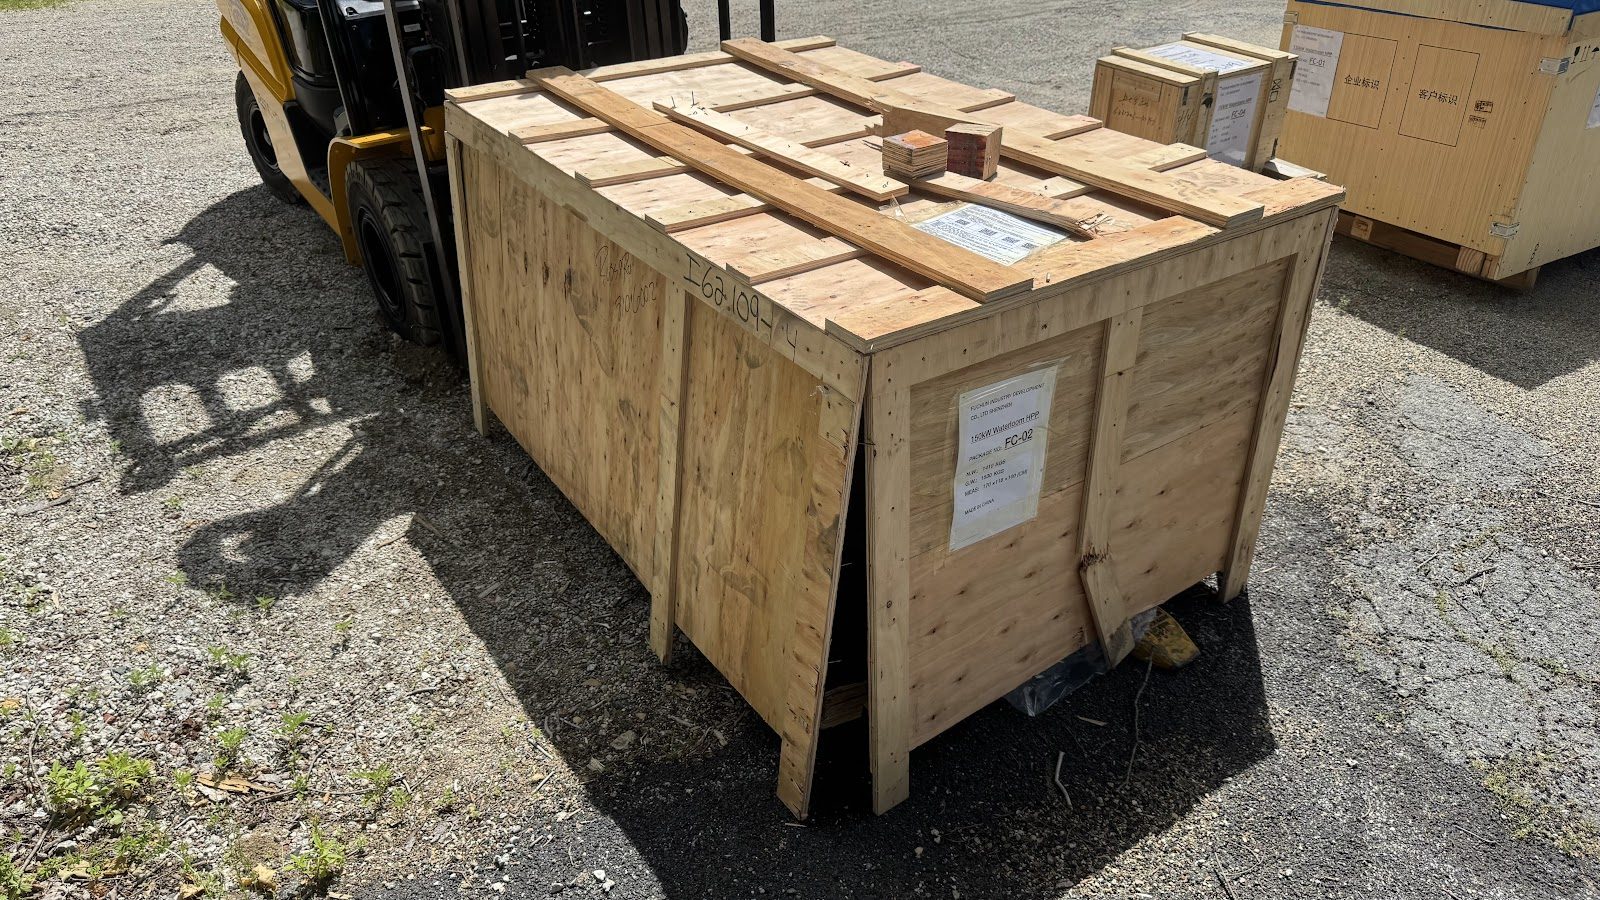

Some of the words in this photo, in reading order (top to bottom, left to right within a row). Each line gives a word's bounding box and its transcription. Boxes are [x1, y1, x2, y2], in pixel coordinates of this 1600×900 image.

[1343, 73, 1380, 91] 企业标识
[1418, 88, 1458, 106] 客户标识
[970, 400, 989, 411] FUCHUN
[990, 393, 1012, 405] INDUSTRY
[1012, 382, 1045, 397] DEVELOPMENT
[980, 410, 989, 418] LTD
[989, 402, 1013, 415] SHENZHEN
[971, 428, 992, 444] 150kW
[993, 416, 1025, 434] Waterloom
[1026, 410, 1040, 422] HPP
[969, 448, 993, 462] PACKAGE
[1004, 428, 1034, 449] FC-02
